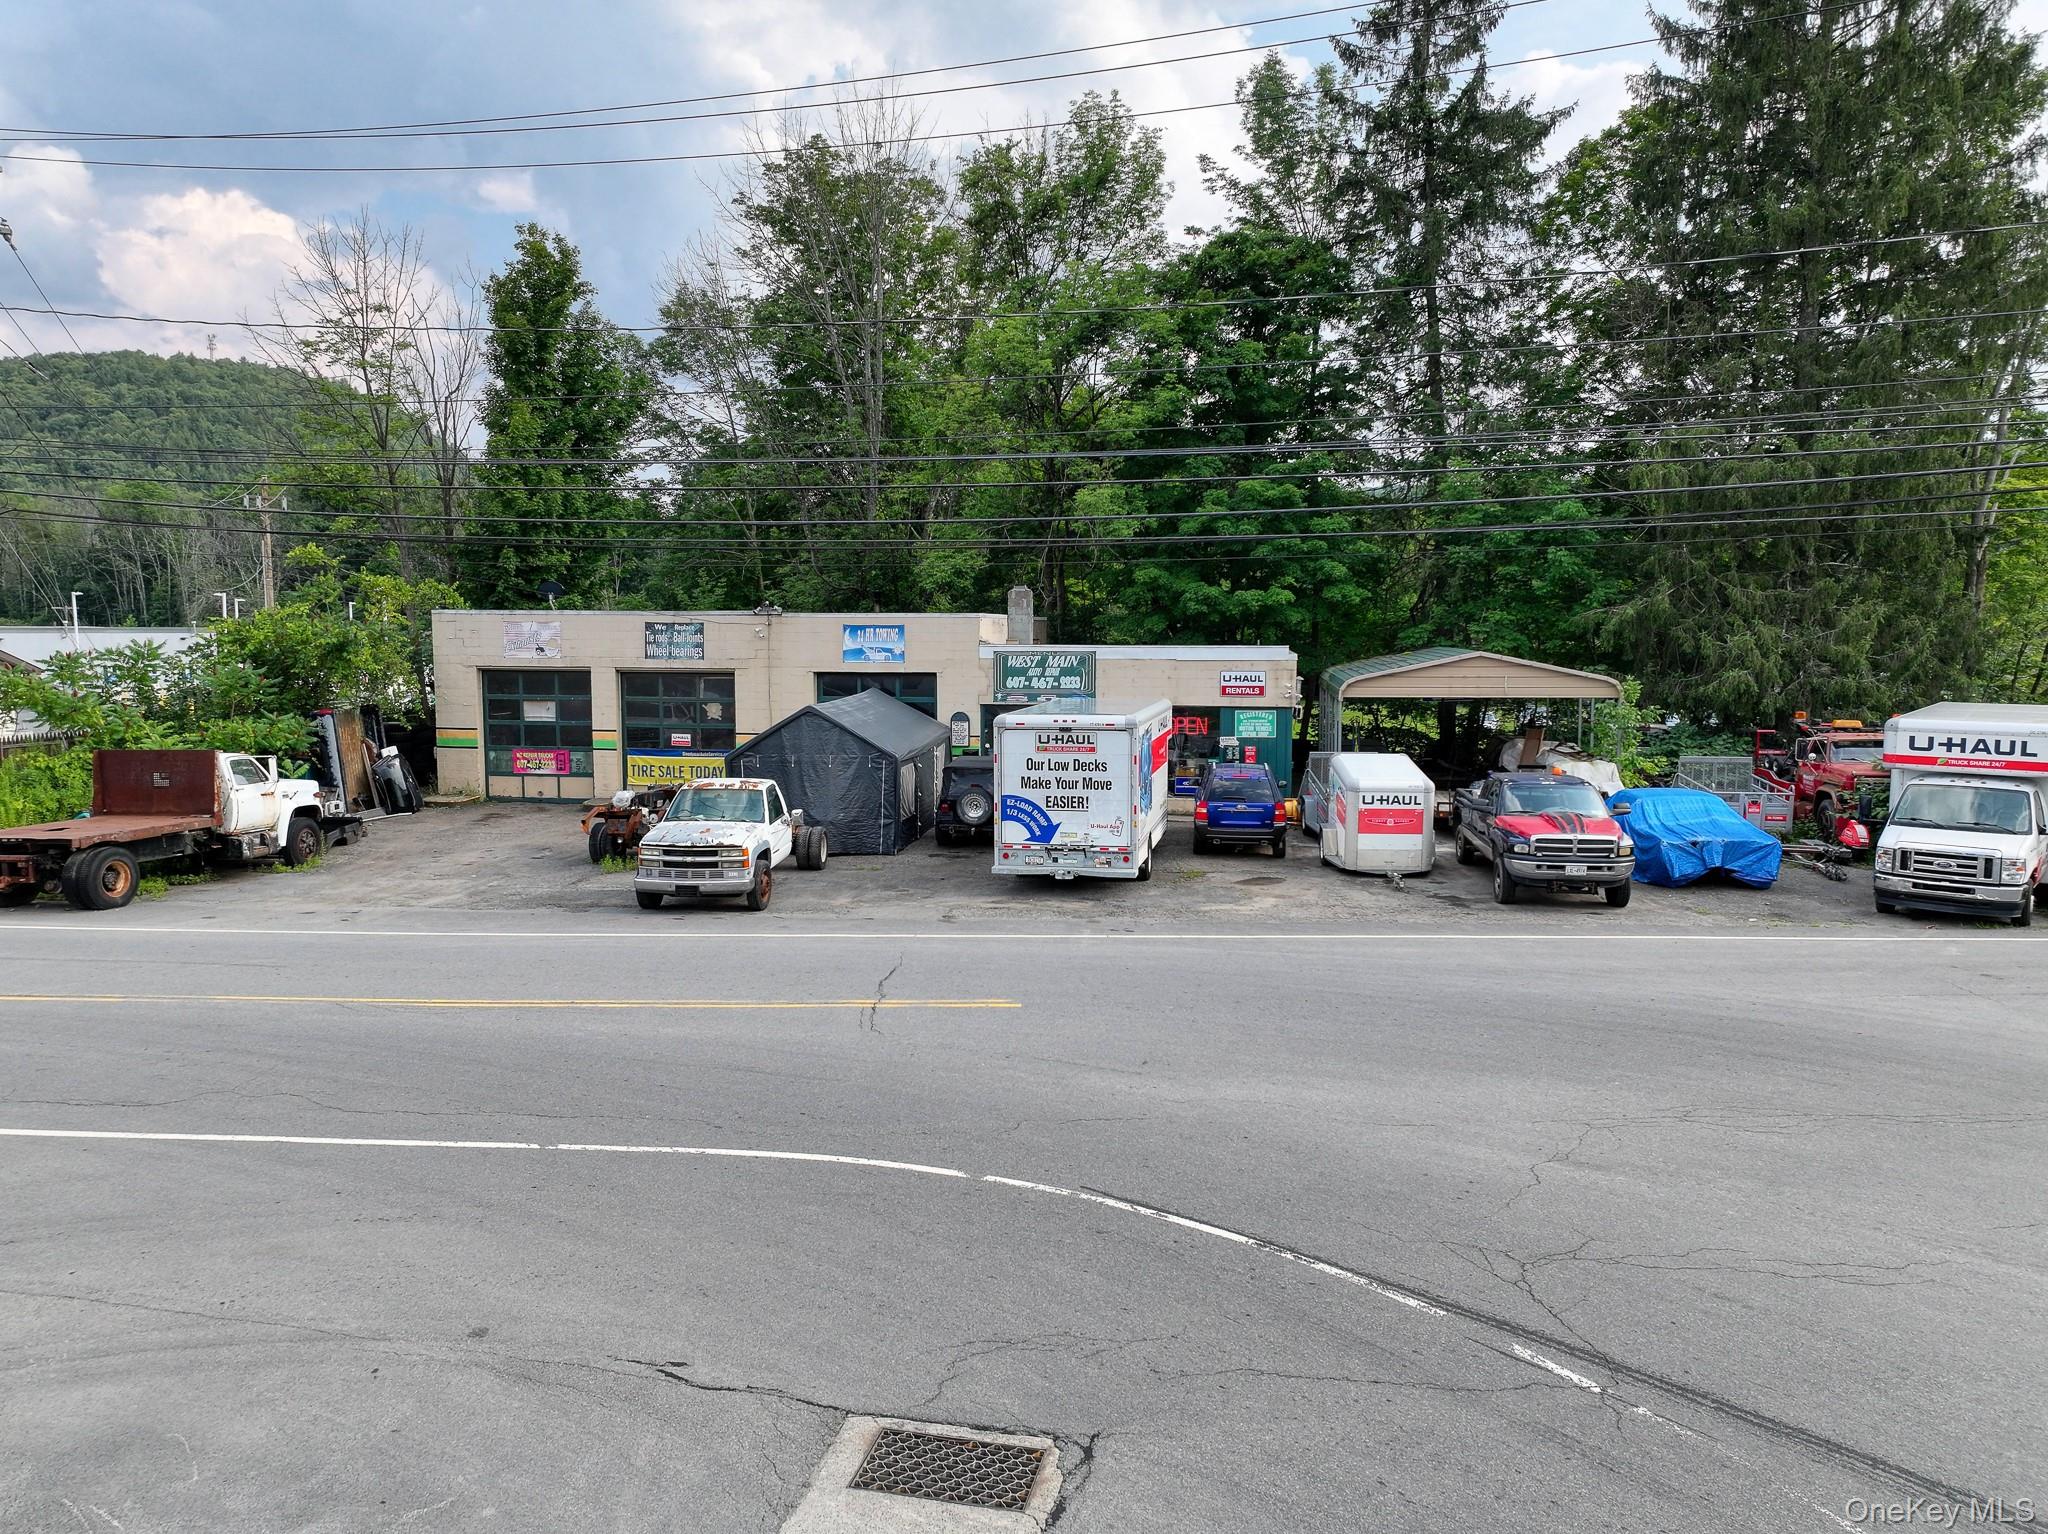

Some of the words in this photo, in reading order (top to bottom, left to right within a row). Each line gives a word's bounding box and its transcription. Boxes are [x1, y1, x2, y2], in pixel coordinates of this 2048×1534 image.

[654, 623, 667, 631] We
[674, 623, 695, 632] Replace
[645, 631, 655, 643] Tie
[655, 631, 668, 643] rods
[865, 628, 874, 642] HR
[875, 628, 899, 642] TOWING
[646, 643, 669, 657] Wheel
[671, 644, 703, 659] bearings
[1007, 655, 1042, 668] WEST
[1044, 655, 1081, 668] MAIN
[1026, 667, 1043, 676] AUTO
[1044, 667, 1061, 676] REPAIR
[1222, 674, 1264, 683] U-HAUL
[1225, 687, 1260, 695] RENTALS
[1038, 734, 1095, 745] U-HAUL
[1908, 735, 2038, 758] U-HAUL
[630, 764, 655, 778] TIRE
[658, 765, 685, 778] SALE
[689, 766, 724, 779] TODAY
[1026, 757, 1045, 771] Our
[1047, 758, 1070, 772] Low
[1073, 758, 1108, 772] Decks
[1020, 776, 1052, 790] Make
[1055, 776, 1079, 790] Your
[1082, 777, 1112, 791] Move
[1045, 795, 1089, 809] EASIER!
[1362, 795, 1422, 806] U-HAUL
[1006, 798, 1033, 813] EZ-LOAD
[1032, 810, 1048, 827] RAMP
[1006, 808, 1018, 816] 1/3
[1017, 812, 1031, 824] LESS
[1029, 821, 1042, 837] WORK
